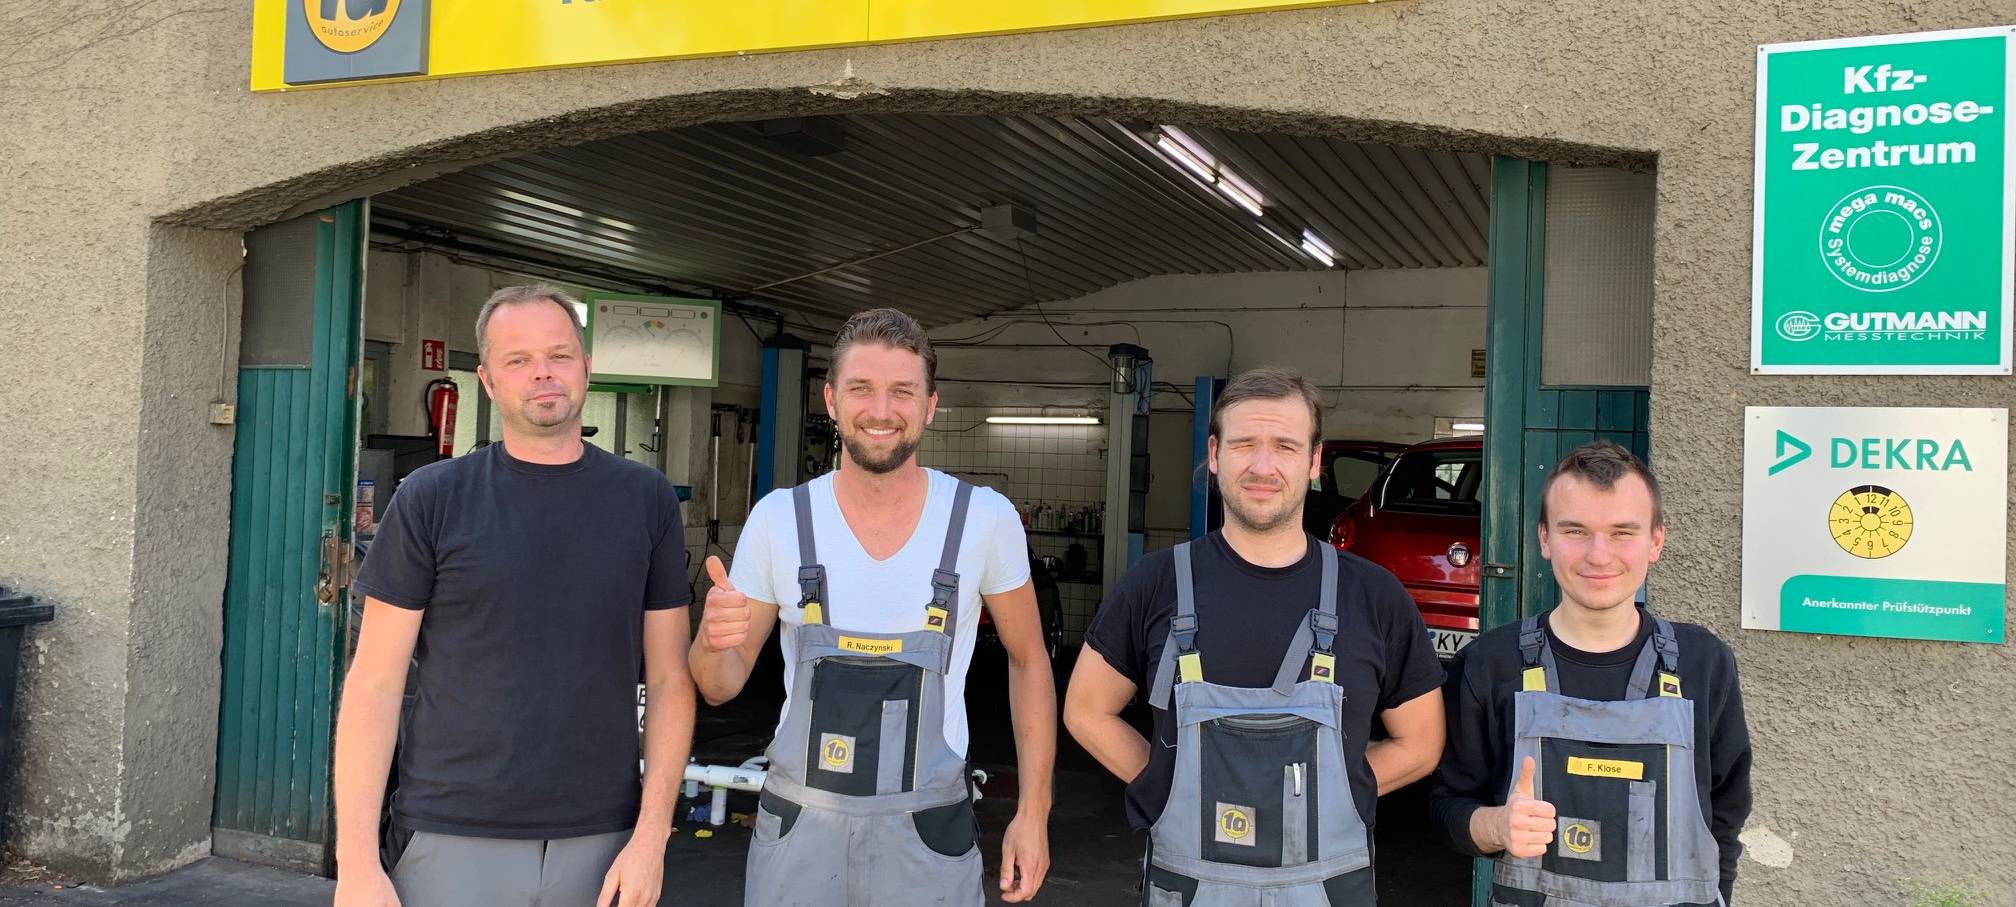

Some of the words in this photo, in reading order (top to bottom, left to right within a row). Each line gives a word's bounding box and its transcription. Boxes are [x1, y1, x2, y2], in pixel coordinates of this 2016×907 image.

[321, 20, 384, 37] autoservice
[1844, 64, 1928, 94] Kfz-
[1781, 100, 1993, 134] Diagnose-
[1791, 140, 1976, 171] Zentrum
[1829, 193, 1878, 233] mega
[1884, 192, 1932, 230] macs
[1826, 236, 1934, 285] Systemdiagnose
[1824, 311, 1987, 331] GUTMANN
[1824, 332, 1985, 341] MESSTECHNIK
[1831, 437, 1973, 472] DEKRA
[1854, 497, 1861, 505] 1
[1866, 494, 1877, 503] 12
[1880, 497, 1890, 507] 11
[1843, 505, 1853, 514] 2
[1888, 506, 1901, 517] 10
[1853, 537, 1862, 546] 5
[1867, 540, 1874, 550] 6
[1881, 538, 1889, 548] 7
[1802, 597, 1878, 611] Anerkannter
[1882, 601, 1972, 616] Prüfstützpunkt
[846, 641, 855, 649] R.
[856, 642, 893, 652] Naczynski
[1587, 763, 1595, 772] F.
[1598, 764, 1621, 773] Klose
[1224, 812, 1246, 832] 1a
[1567, 826, 1591, 847] 1a
